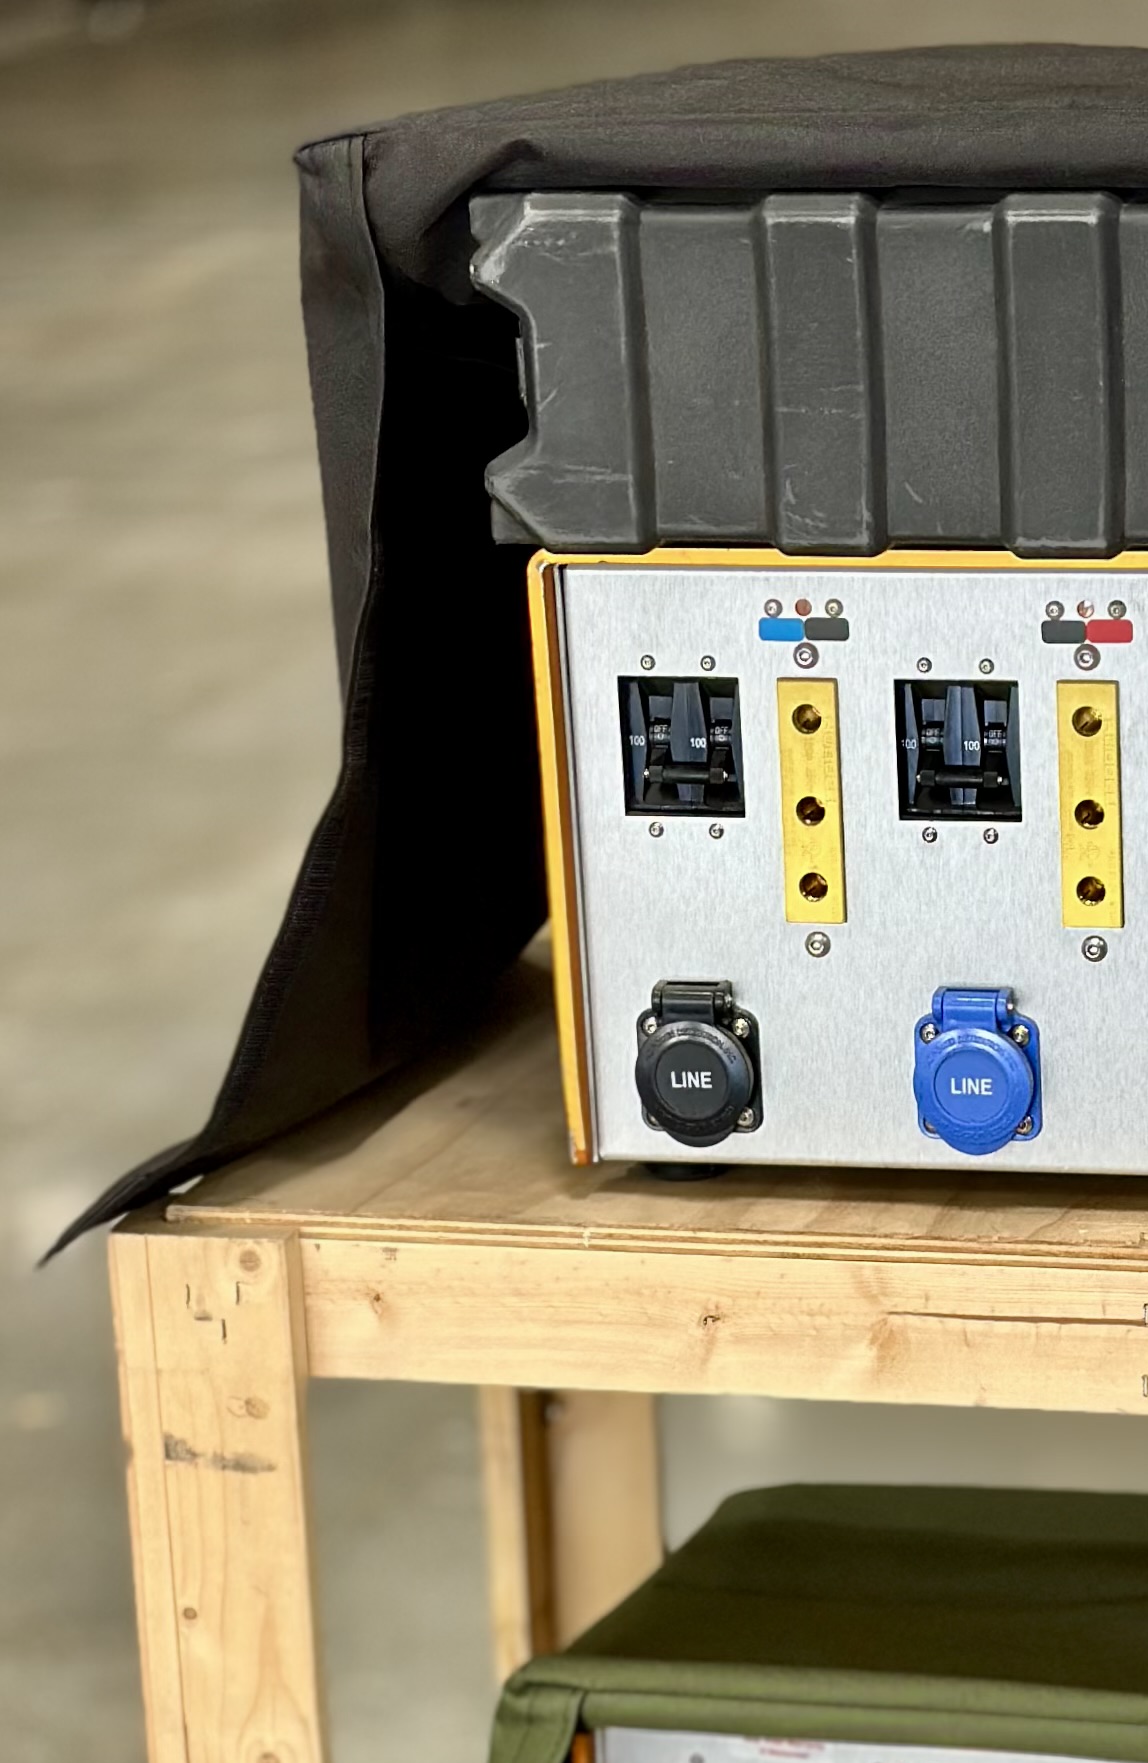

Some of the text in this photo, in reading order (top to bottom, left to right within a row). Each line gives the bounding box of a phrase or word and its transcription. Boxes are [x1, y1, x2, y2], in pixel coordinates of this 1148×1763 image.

[629, 735, 646, 746] 100
[689, 737, 707, 748] 100
[963, 741, 980, 751] 100
[670, 1071, 713, 1089] LINE
[950, 1077, 993, 1096] LINE
